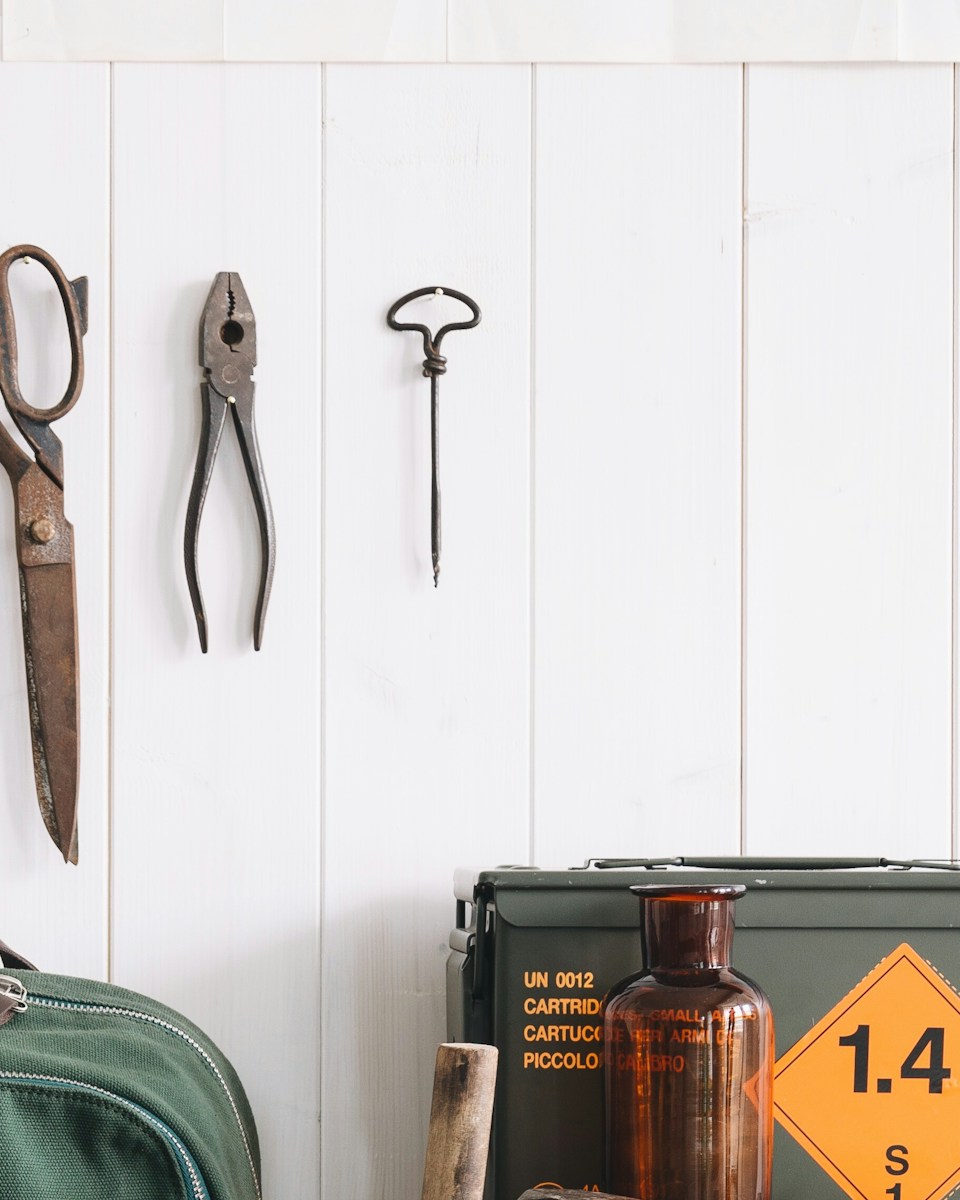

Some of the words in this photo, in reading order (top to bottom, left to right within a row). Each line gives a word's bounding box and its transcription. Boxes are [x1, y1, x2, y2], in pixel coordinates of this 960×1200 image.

[524, 972, 548, 988] UN
[556, 972, 594, 989] 0012
[524, 1052, 600, 1069] PICCOLO
[839, 1024, 951, 1093] 1.4
[885, 1144, 909, 1176] S
